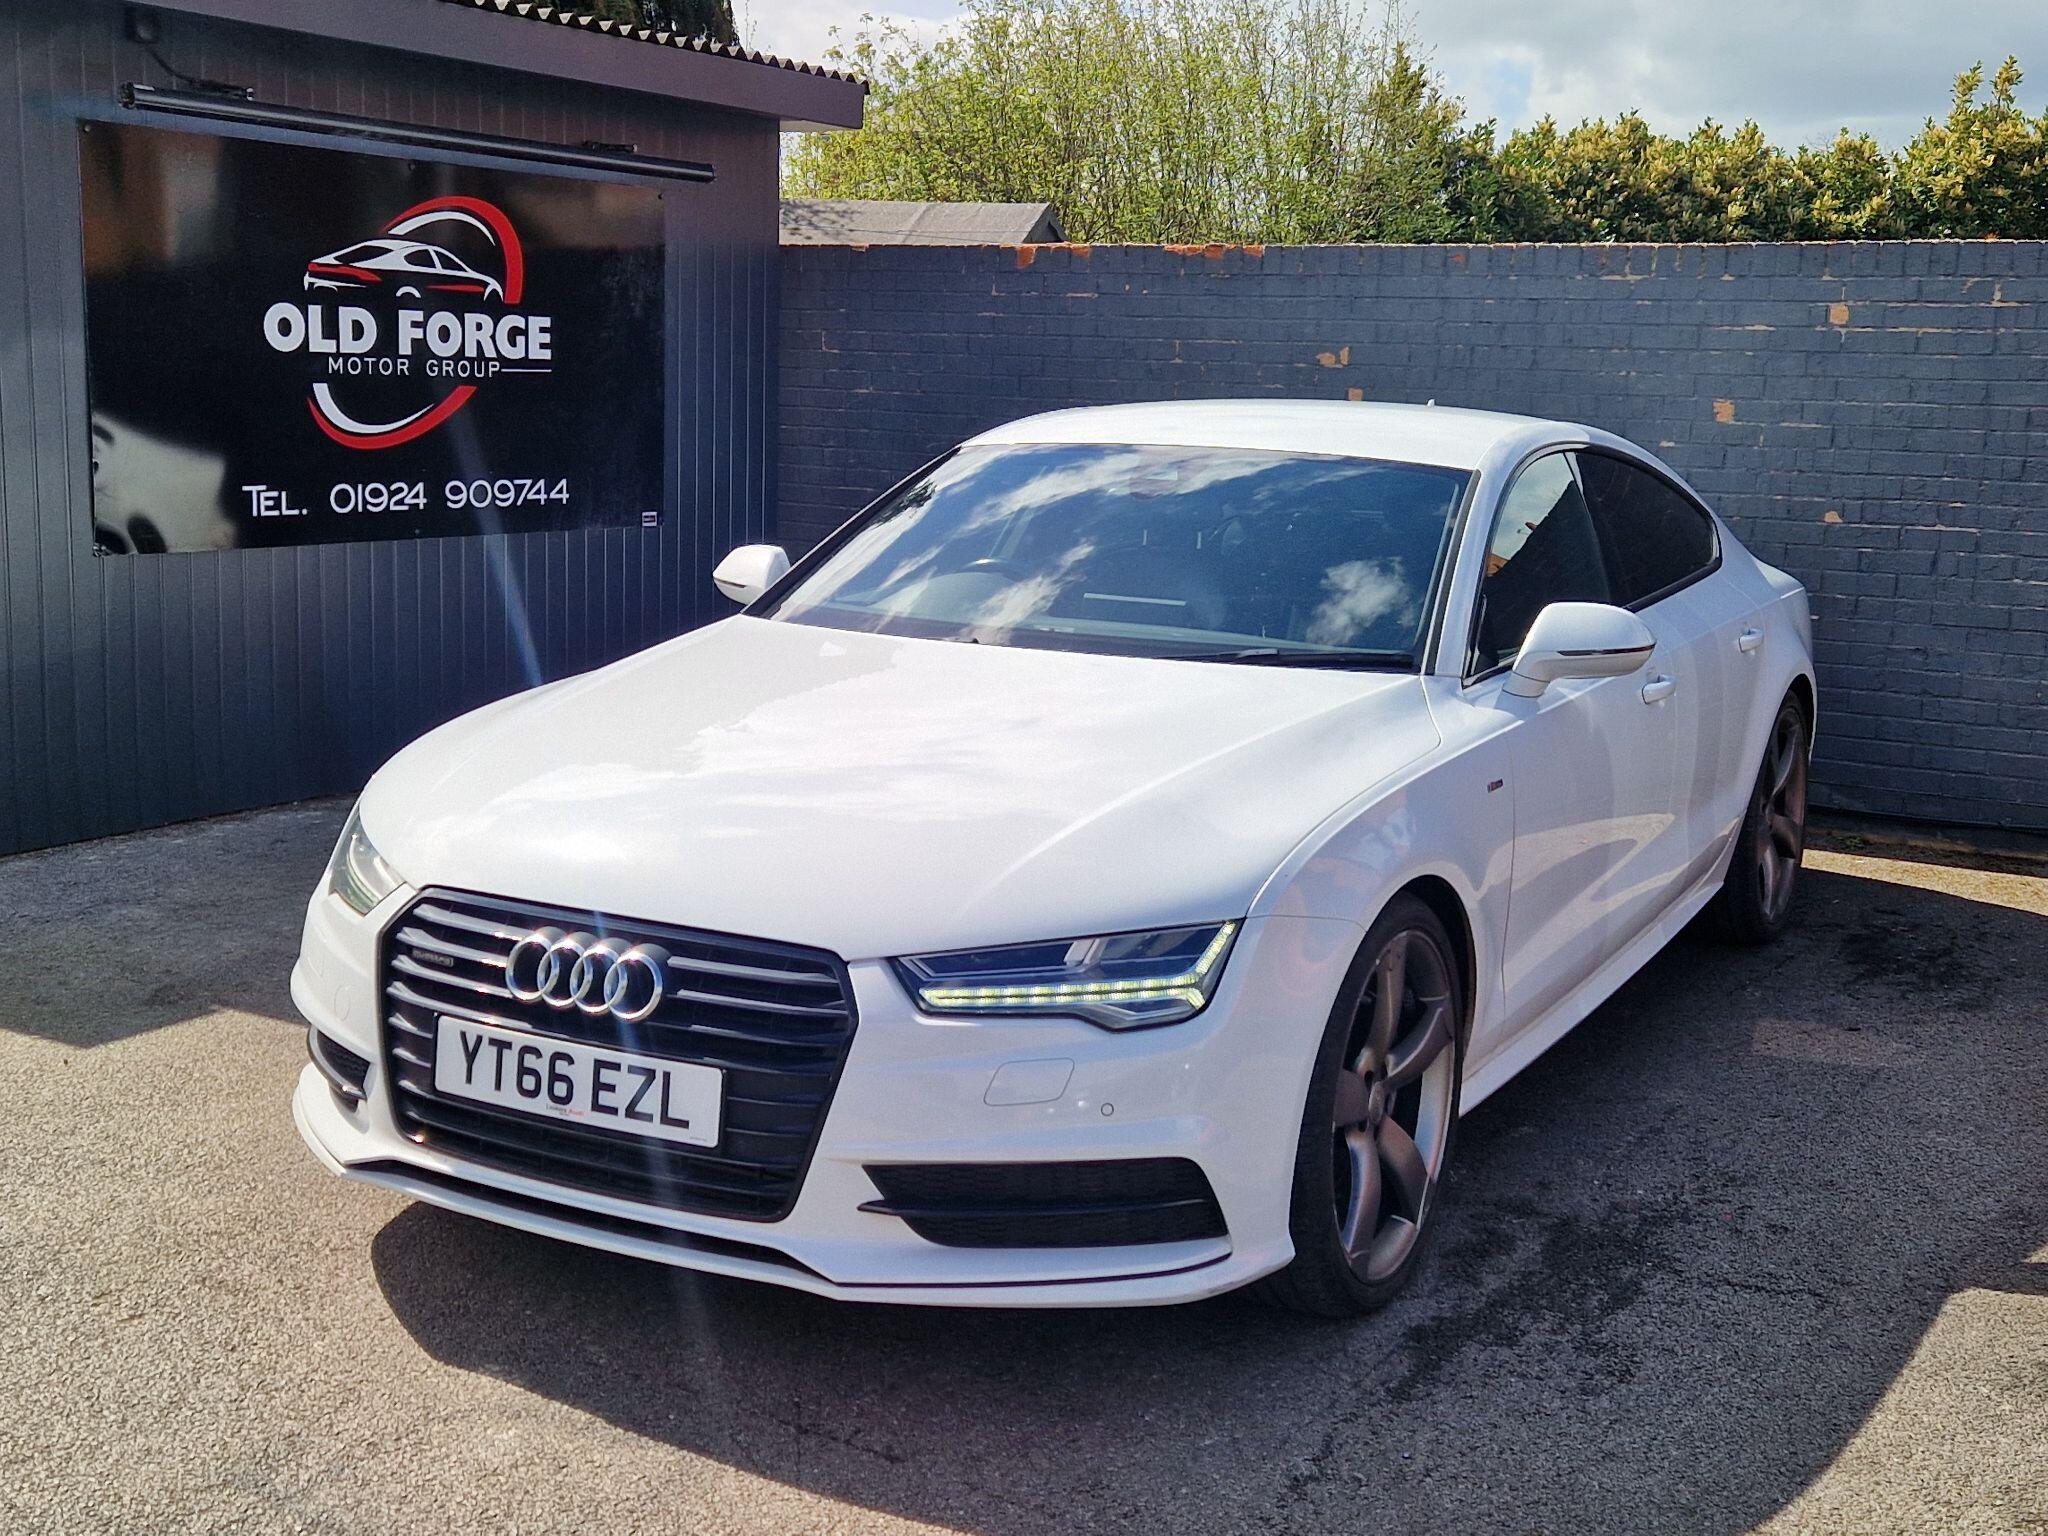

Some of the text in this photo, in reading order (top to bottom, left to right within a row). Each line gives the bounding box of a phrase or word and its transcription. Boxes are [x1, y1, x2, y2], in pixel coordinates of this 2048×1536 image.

[263, 302, 552, 360] OLD FORGE
[328, 356, 500, 378] MOTOR GROUP
[241, 478, 570, 517] TEL. 01924 909744
[459, 1029, 690, 1129] YT66 EZL
